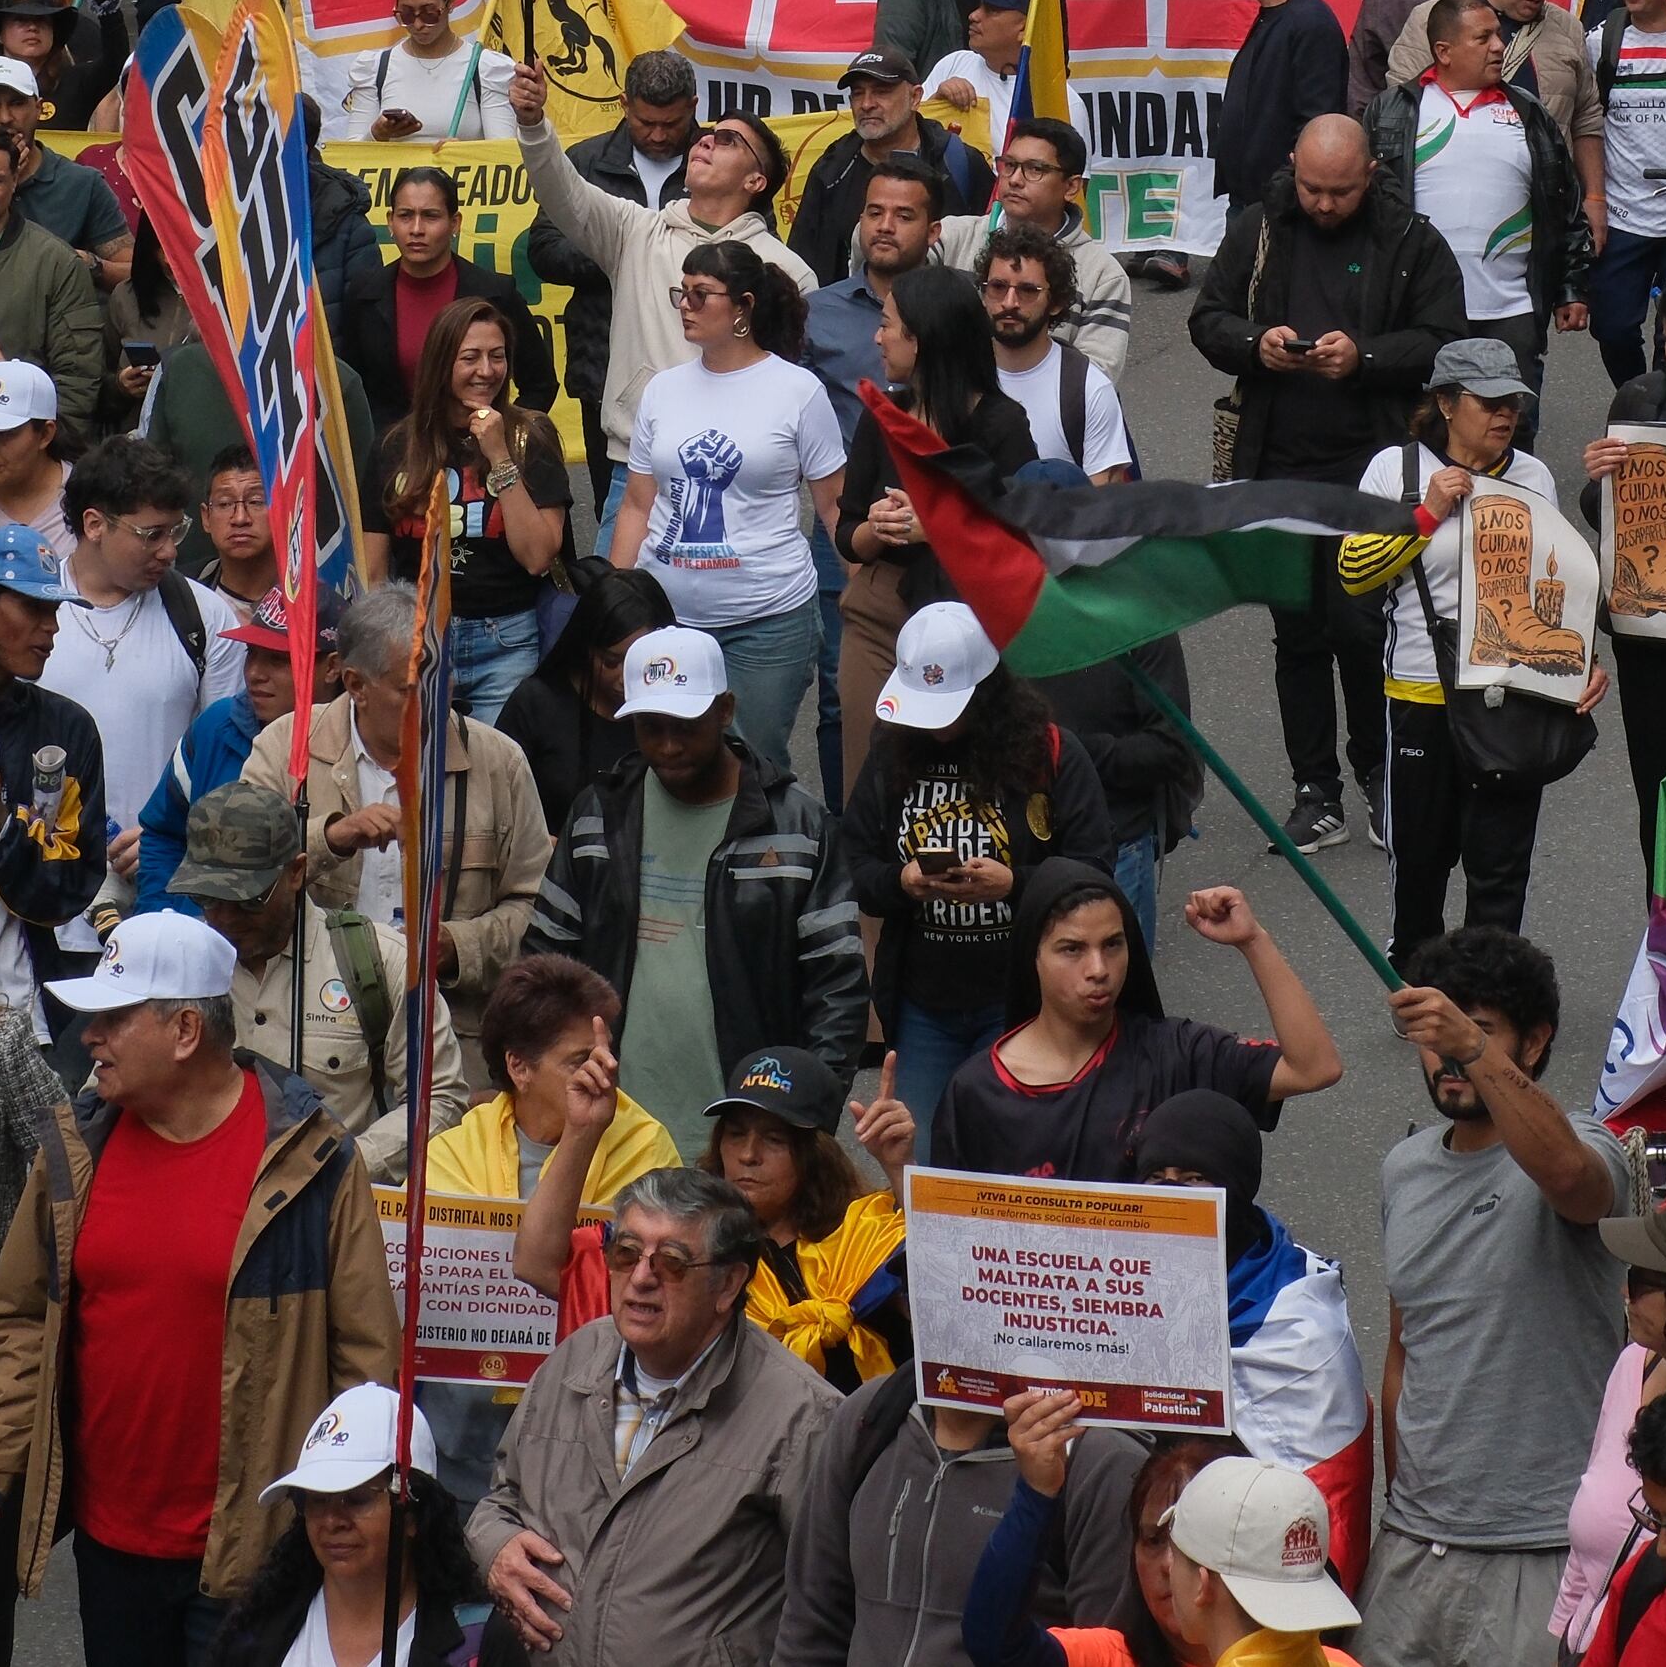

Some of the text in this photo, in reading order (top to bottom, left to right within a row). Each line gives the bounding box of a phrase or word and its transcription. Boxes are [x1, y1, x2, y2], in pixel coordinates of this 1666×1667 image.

[1635, 113, 1650, 123] OF
[1617, 458, 1666, 481] ¿NOS
[656, 477, 685, 565] CUNDINAMARCA
[1479, 509, 1524, 531] ¿NOS
[1622, 508, 1634, 524] O
[1479, 533, 1528, 554] CUIDAN
[673, 557, 741, 570] NO SE ENAMORA
[1481, 556, 1526, 575] O NOS
[1642, 545, 1659, 574] ?
[1499, 598, 1513, 628] ?
[1399, 747, 1425, 757] FSO
[739, 1069, 793, 1094] Aruba
[975, 1191, 1144, 1214] ¡VIVA LA CONSULTA POPULAR!
[428, 1205, 514, 1228] DISTRITAL NOS
[971, 1206, 1151, 1230] y las reformas sociales del cambio
[971, 1245, 1152, 1277] UNA ESCUELA QUE
[440, 1265, 510, 1281] PARA EL
[977, 1267, 1144, 1297] MALTRATA A SUS
[483, 1281, 527, 1298] PARA
[426, 1298, 556, 1319] CON DIGNIDAD.
[962, 1285, 1164, 1320] DOCENTES, SIEMBRA
[1003, 1311, 1117, 1338] INJUSTICIA.
[472, 1327, 551, 1347] NO DEJARÁ DE
[992, 1332, 1130, 1356] ¡No callaremos más!
[484, 1358, 501, 1371] 68
[1143, 1389, 1186, 1401] Solidaridad
[1143, 1400, 1201, 1417] Palestina!
